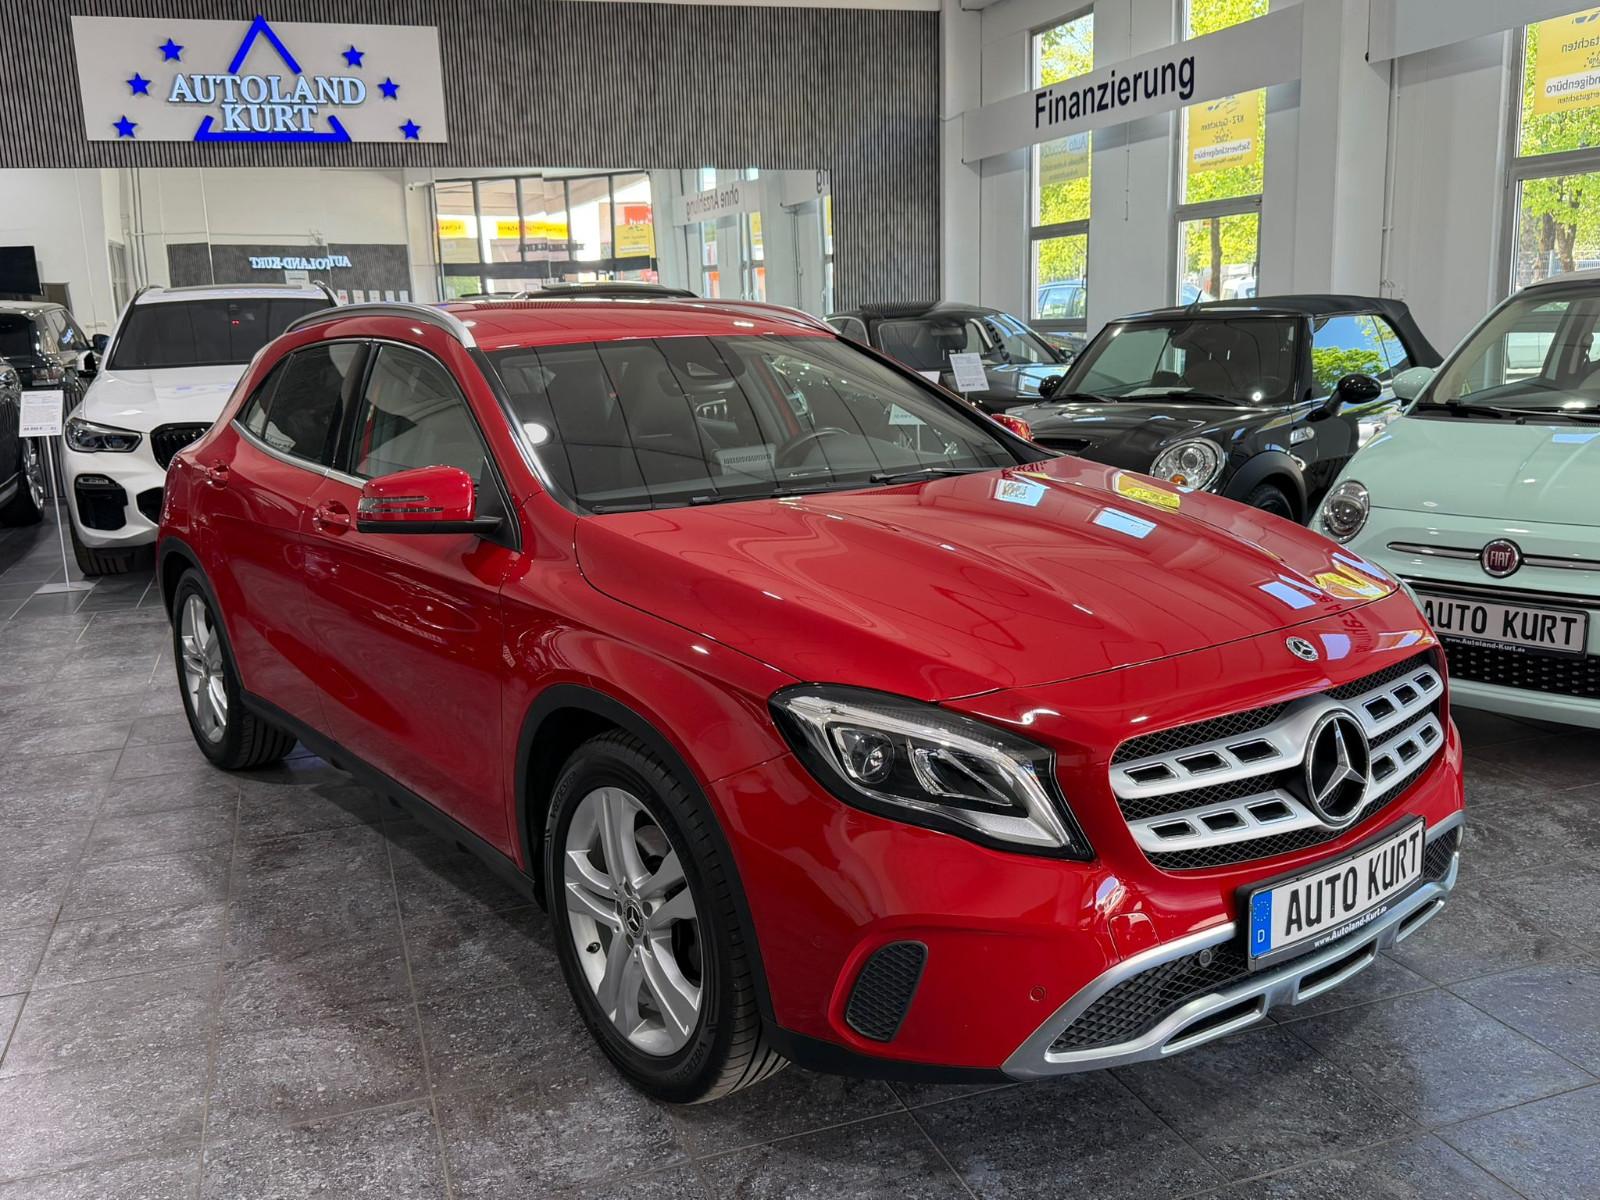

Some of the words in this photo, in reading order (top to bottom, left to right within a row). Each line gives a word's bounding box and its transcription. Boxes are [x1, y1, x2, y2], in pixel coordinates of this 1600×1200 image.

[168, 73, 366, 105] AUTOLAND
[1035, 56, 1195, 128] Finanzierung
[221, 103, 319, 133] KURT
[1489, 550, 1512, 567] FIAT
[1425, 600, 1488, 634] AUTO
[1502, 610, 1577, 645] KURT
[1257, 929, 1265, 944] D
[1285, 866, 1358, 937] AUTO
[1367, 830, 1420, 901] KURT
